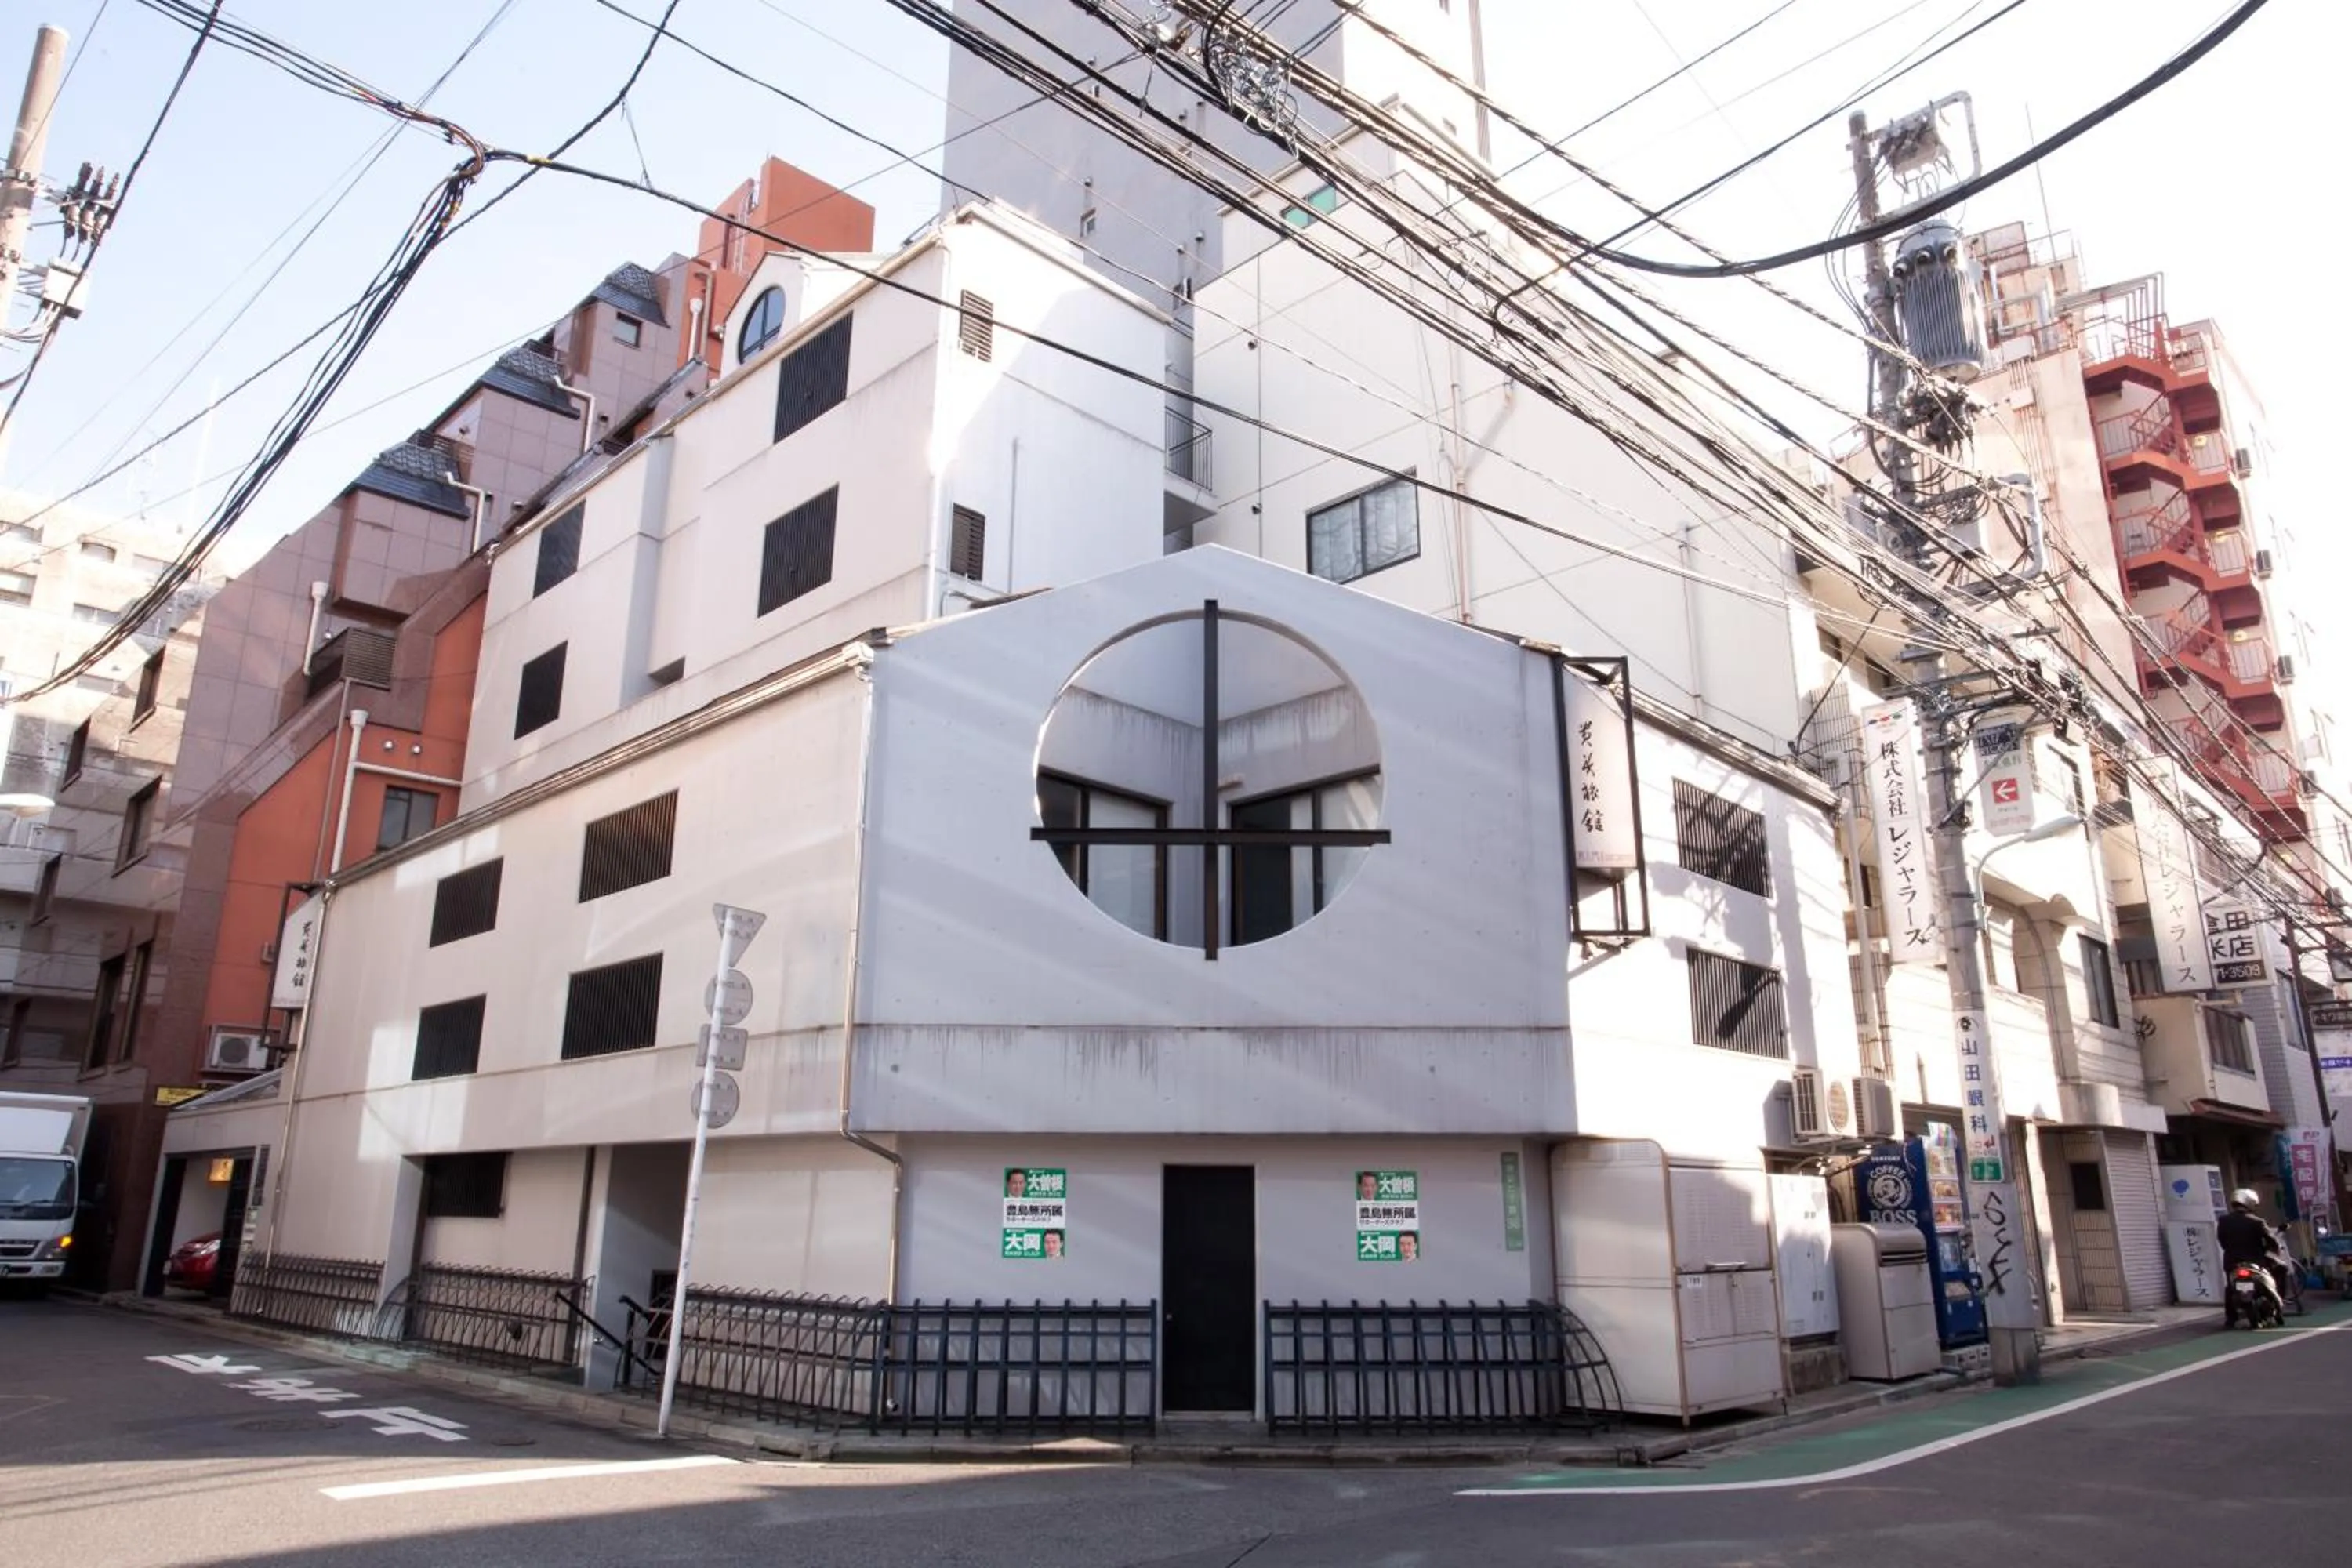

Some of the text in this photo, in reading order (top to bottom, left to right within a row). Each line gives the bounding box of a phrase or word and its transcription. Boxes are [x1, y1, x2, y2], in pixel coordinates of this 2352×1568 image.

[1881, 739, 1928, 947] 株式会社レジャラース
[1961, 1037, 1988, 1134] 山田眼科
[1869, 1164, 1907, 1178] COFFEE
[1869, 1209, 1918, 1224] BOSS
